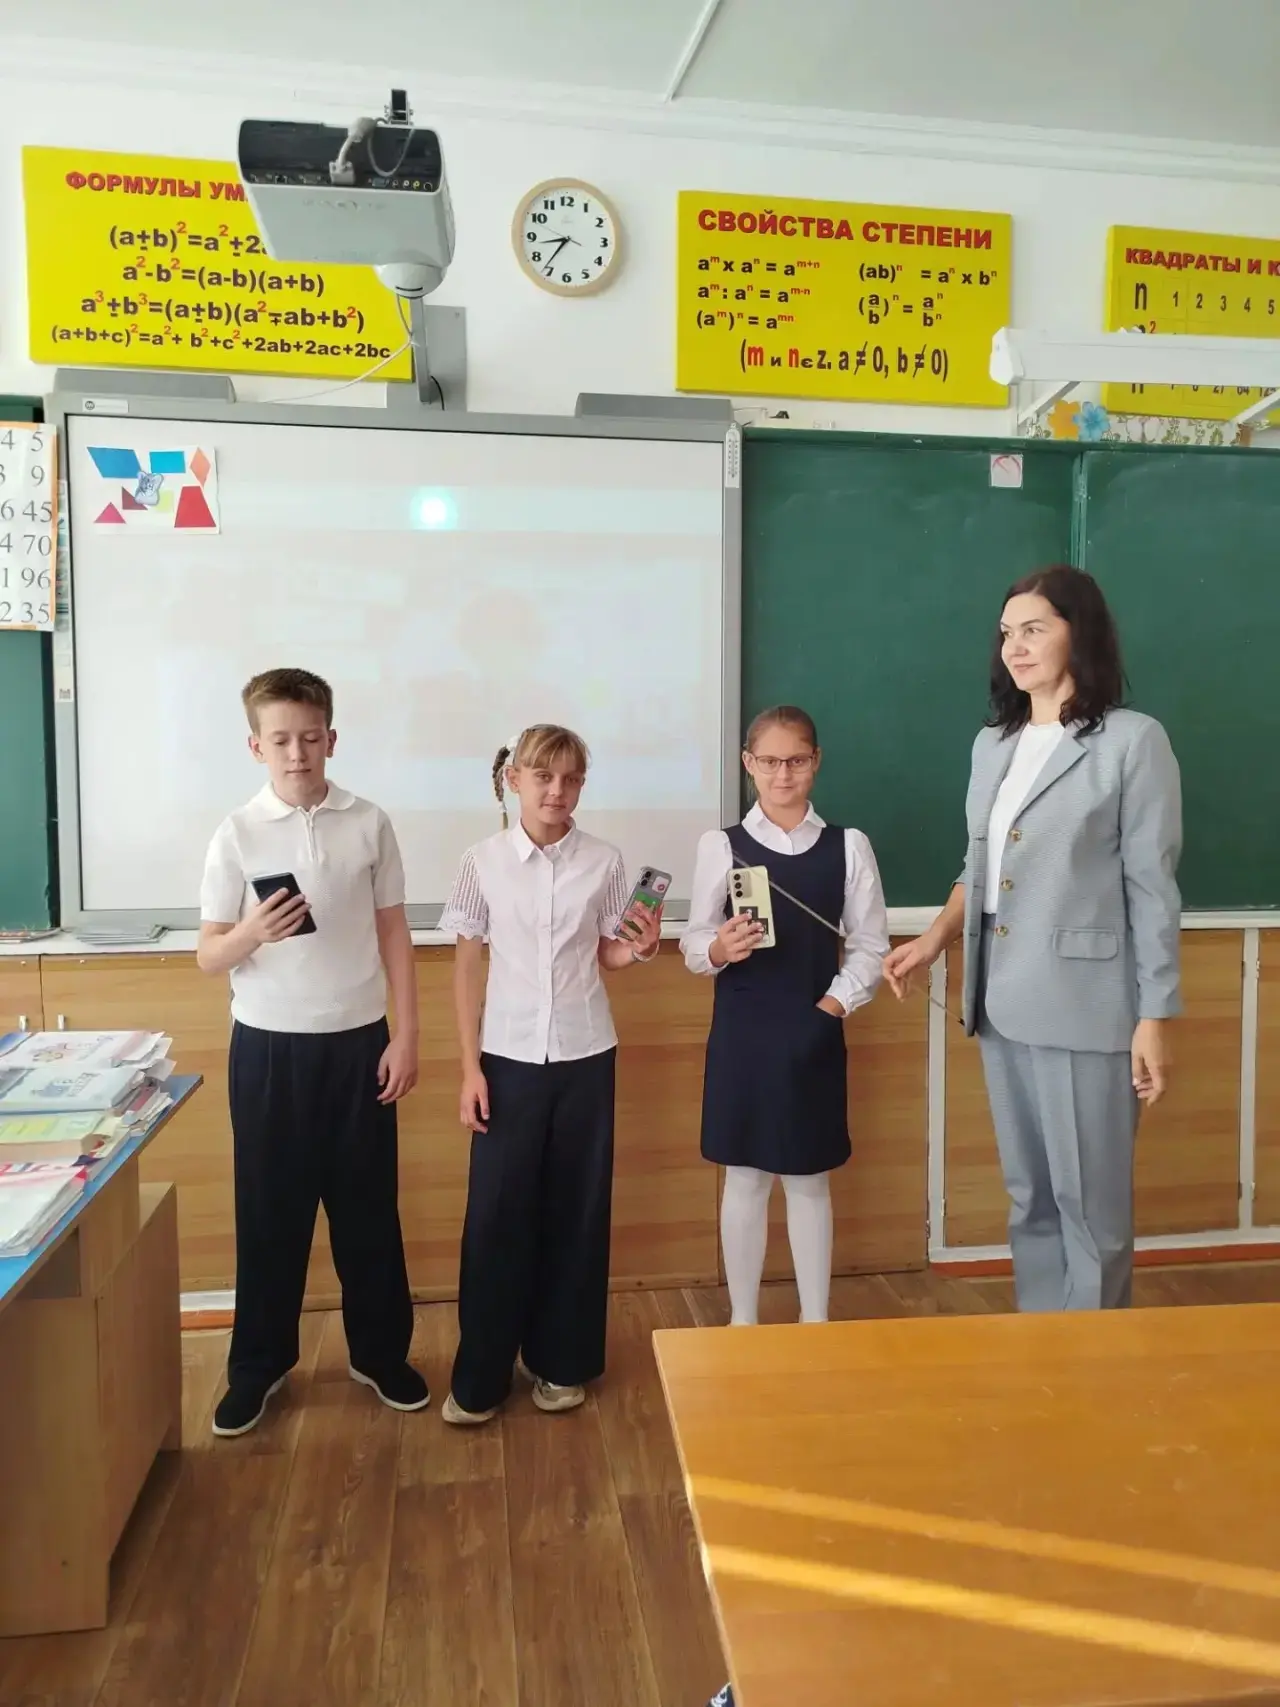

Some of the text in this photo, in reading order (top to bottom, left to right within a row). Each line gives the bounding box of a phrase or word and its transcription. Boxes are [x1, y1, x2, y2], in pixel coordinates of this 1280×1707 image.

[66, 171, 248, 202] ФОРМУЛЫ УМ
[543, 200, 555, 211] 11
[560, 196, 575, 207] 12
[583, 202, 589, 213] 1
[531, 213, 548, 224] 10
[594, 217, 604, 228] 2
[698, 209, 992, 250] СВОЙСТВА СТЕПЕНИ
[526, 232, 537, 242] 9
[600, 237, 608, 248] 3
[532, 252, 542, 262] 8
[594, 256, 603, 266] 4
[1125, 248, 1241, 273] КВАДРАТЫ
[1247, 258, 1262, 275] И
[544, 266, 554, 277] 7
[581, 269, 590, 279] 5
[562, 273, 572, 283] 6
[1134, 282, 1275, 315] n 1 2 3 4 5
[1, 430, 43, 452] 4 5
[31, 465, 45, 488] 9
[1, 498, 53, 523] 6 45
[23, 535, 52, 557] 70
[3, 567, 51, 589] 1 96
[21, 602, 50, 625] 35
